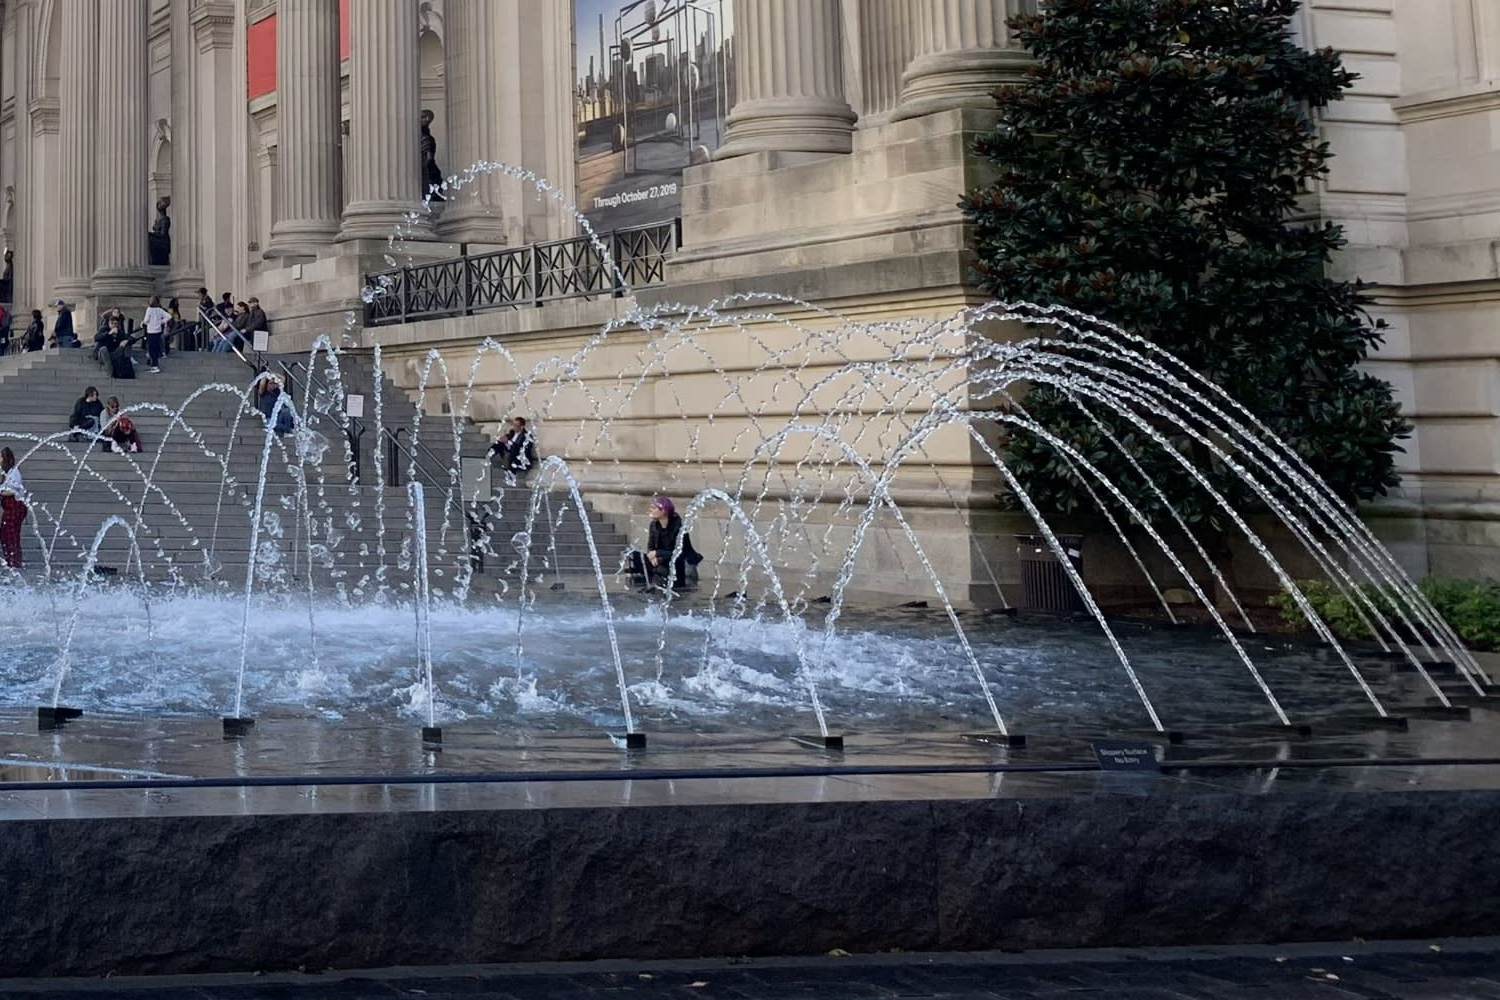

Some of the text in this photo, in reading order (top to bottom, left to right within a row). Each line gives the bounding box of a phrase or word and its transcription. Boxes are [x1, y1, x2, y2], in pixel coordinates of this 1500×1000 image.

[593, 182, 677, 209] Through October 27, 2019
